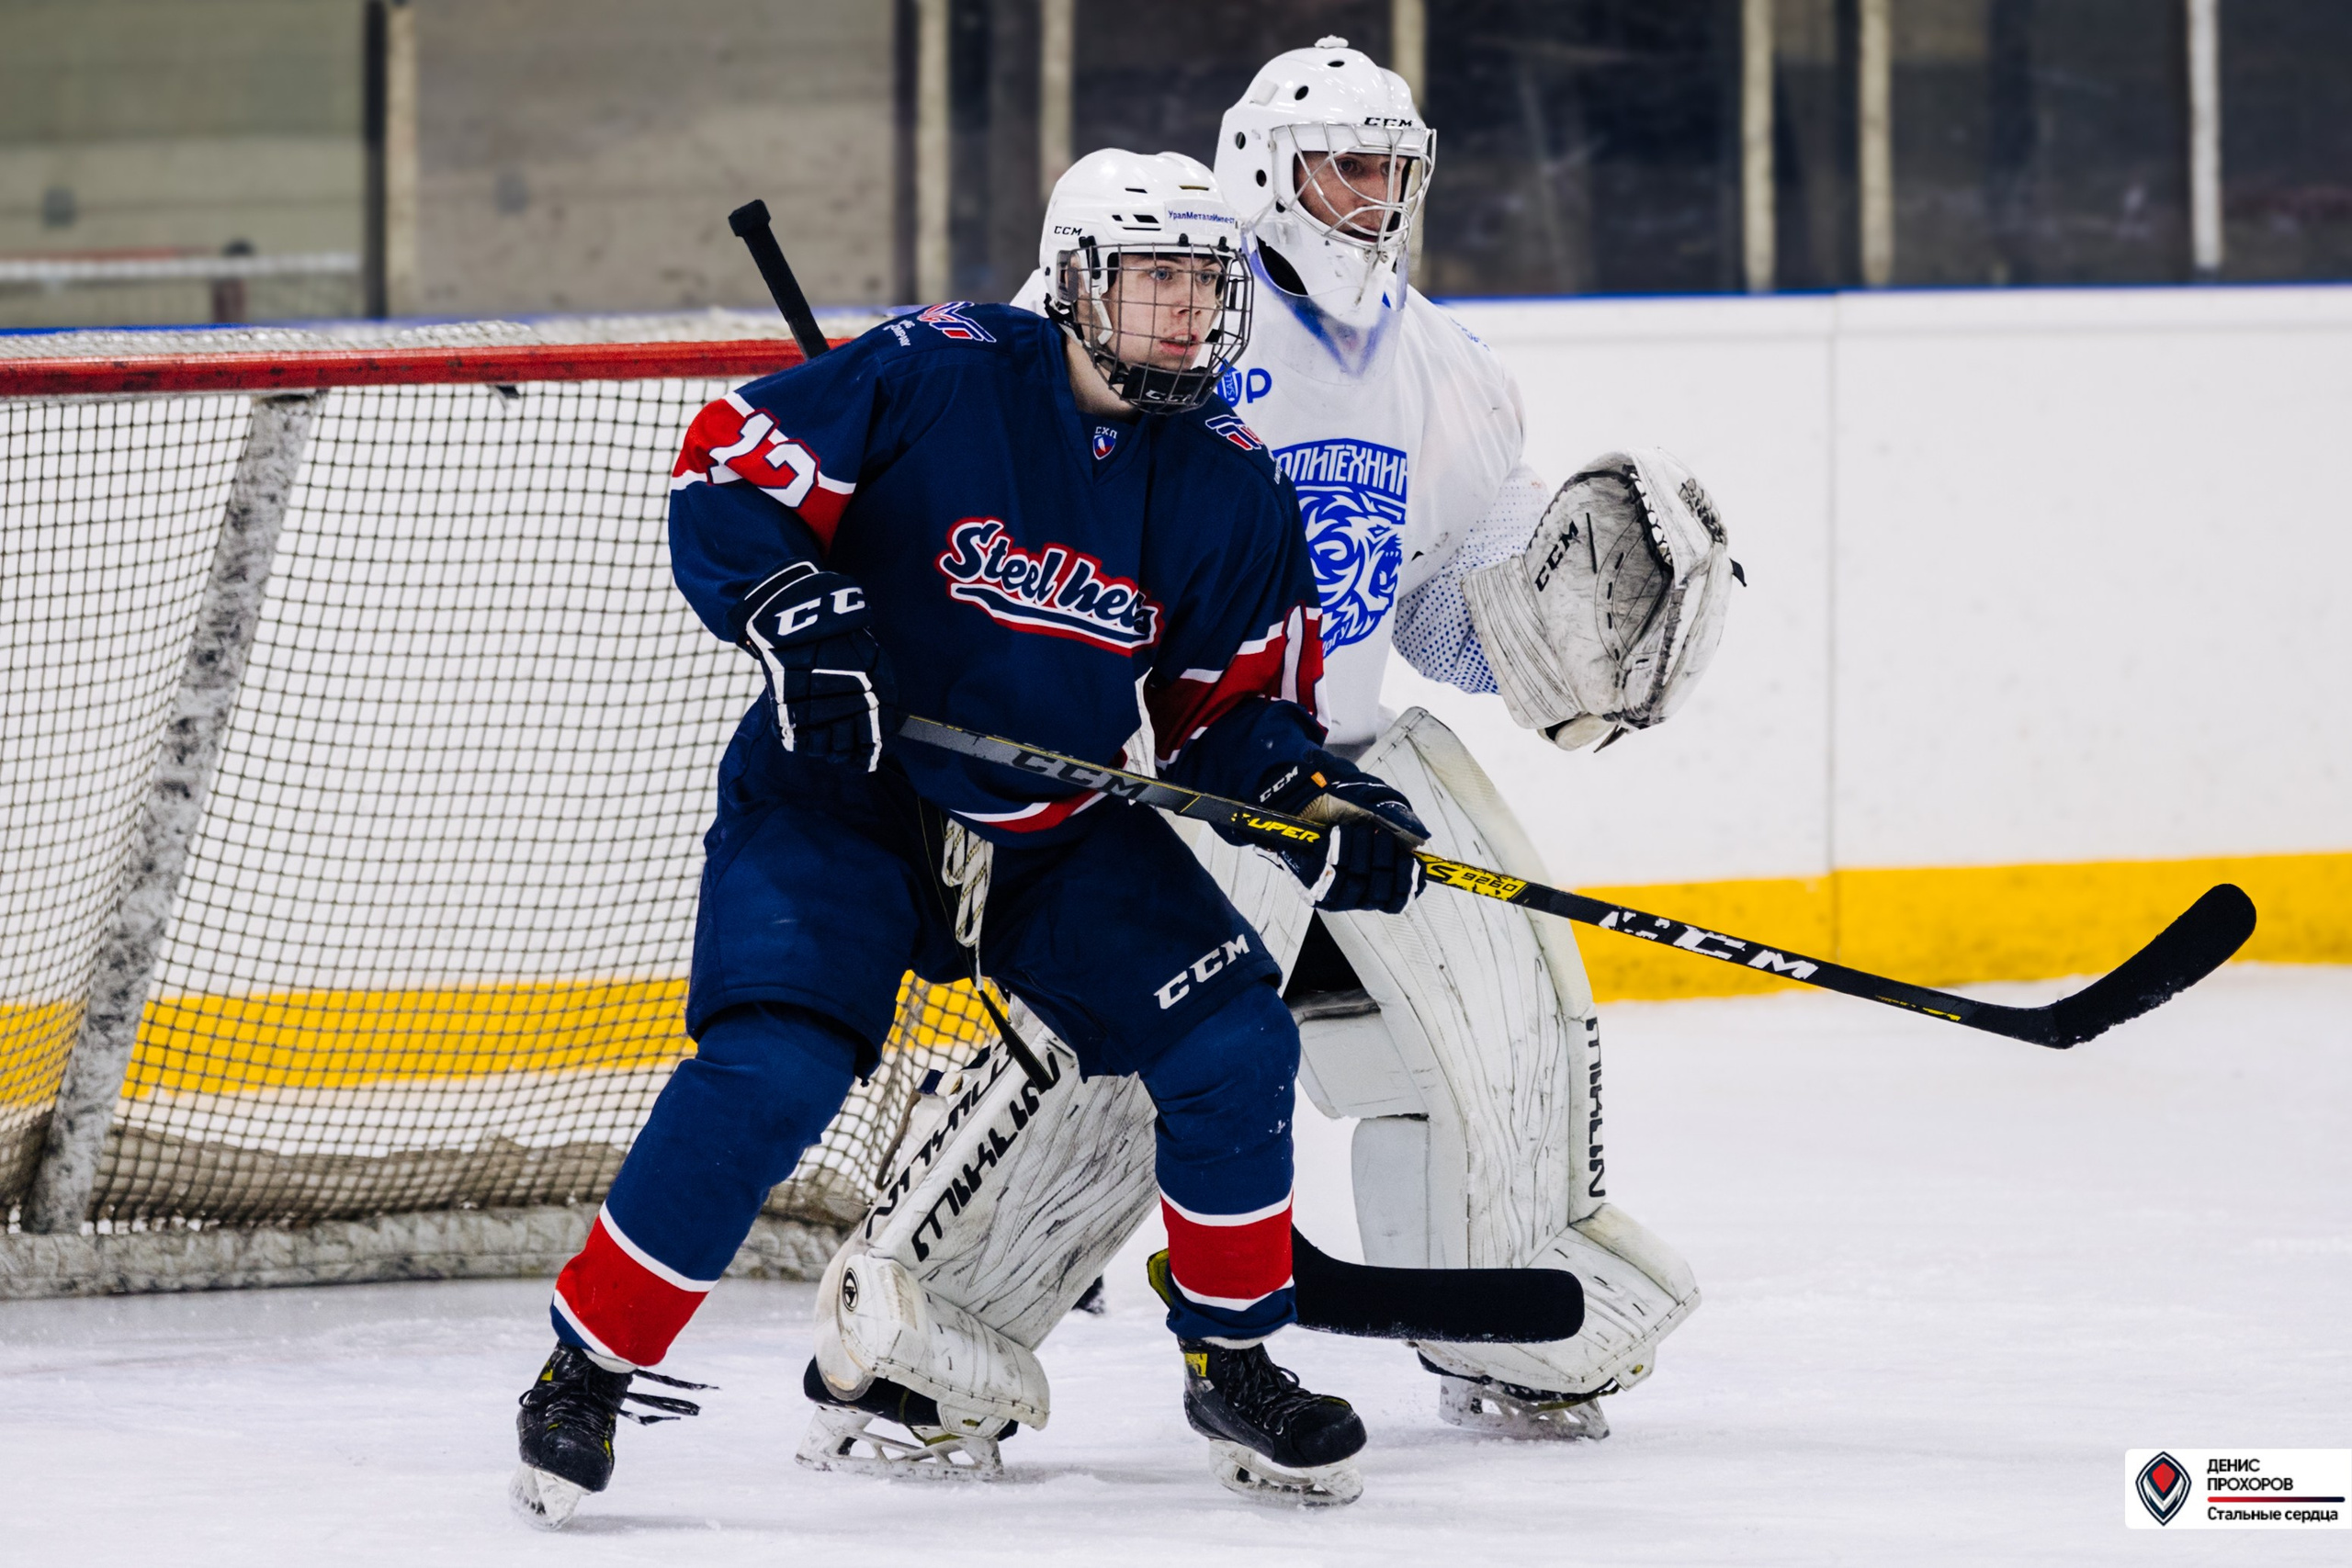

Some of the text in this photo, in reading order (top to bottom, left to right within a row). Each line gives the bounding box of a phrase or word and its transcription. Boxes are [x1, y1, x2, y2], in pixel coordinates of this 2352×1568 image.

[1363, 117, 1413, 127] CCM
[1054, 225, 1083, 236] CCM
[939, 519, 1068, 607] Steel
[1534, 520, 1579, 592] CCM
[774, 586, 866, 637] CC
[1011, 749, 1149, 800] CCM
[1259, 765, 1298, 803] CCM
[1461, 872, 1518, 893] 9260
[1153, 933, 1250, 1010] CCM
